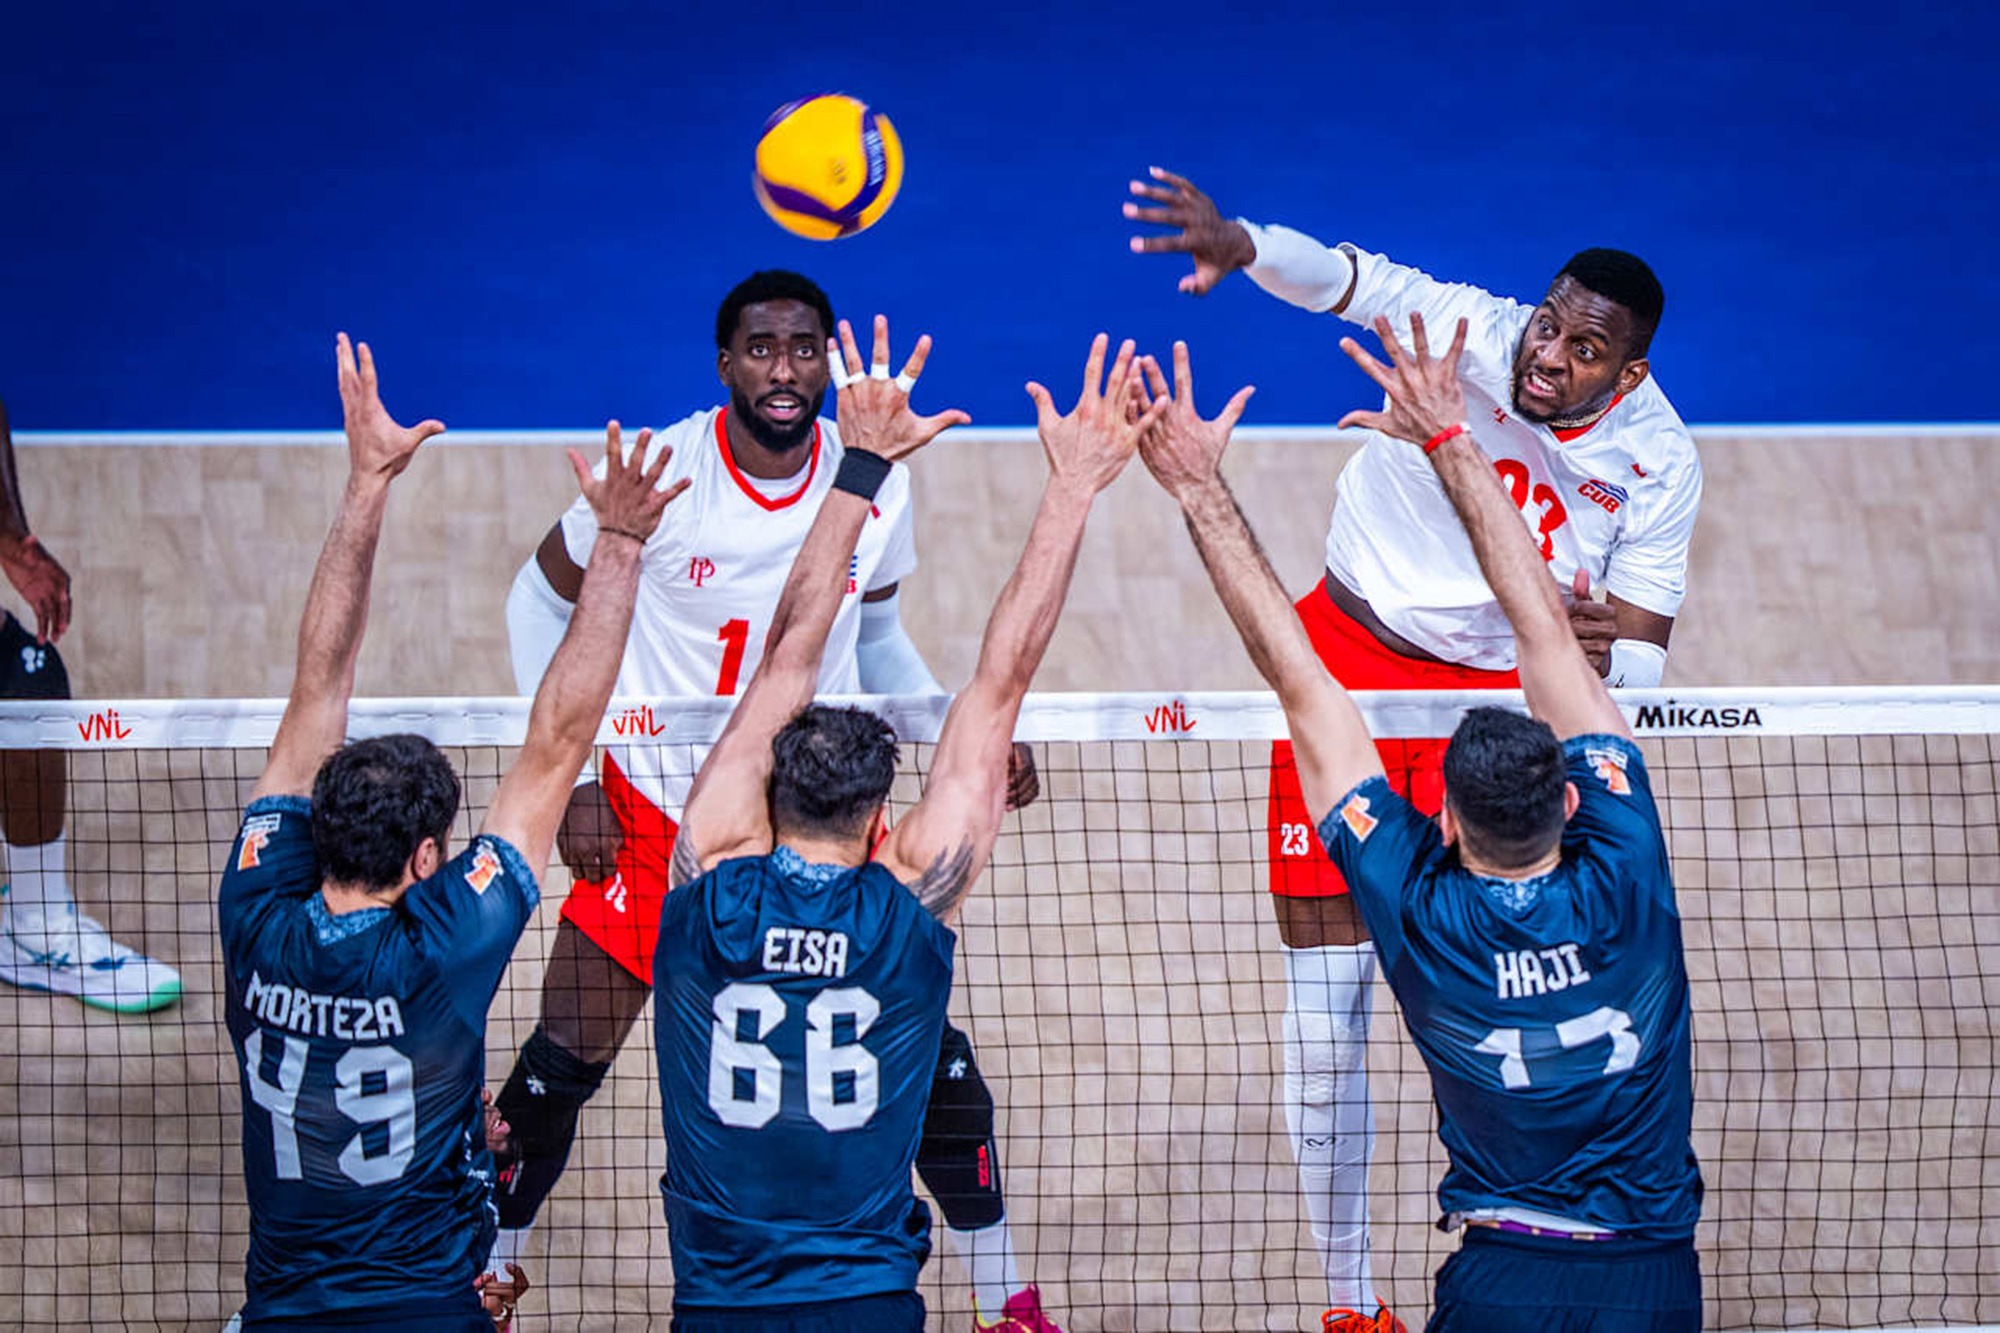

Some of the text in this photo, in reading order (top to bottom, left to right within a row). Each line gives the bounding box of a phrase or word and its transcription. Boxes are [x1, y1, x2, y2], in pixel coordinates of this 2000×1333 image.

[1577, 482, 1620, 514] CUB
[78, 708, 132, 742] VNL
[613, 705, 666, 737] VNL
[1144, 701, 1197, 734] VNL
[1635, 699, 1763, 729] MIKASA
[1280, 823, 1309, 856] 23
[762, 927, 849, 978] EISA
[1494, 943, 1591, 1000] HAJI
[245, 971, 404, 1040] MORTEZA
[707, 983, 881, 1132] 66
[1474, 1006, 1642, 1089] 17
[244, 1028, 416, 1186] 49
